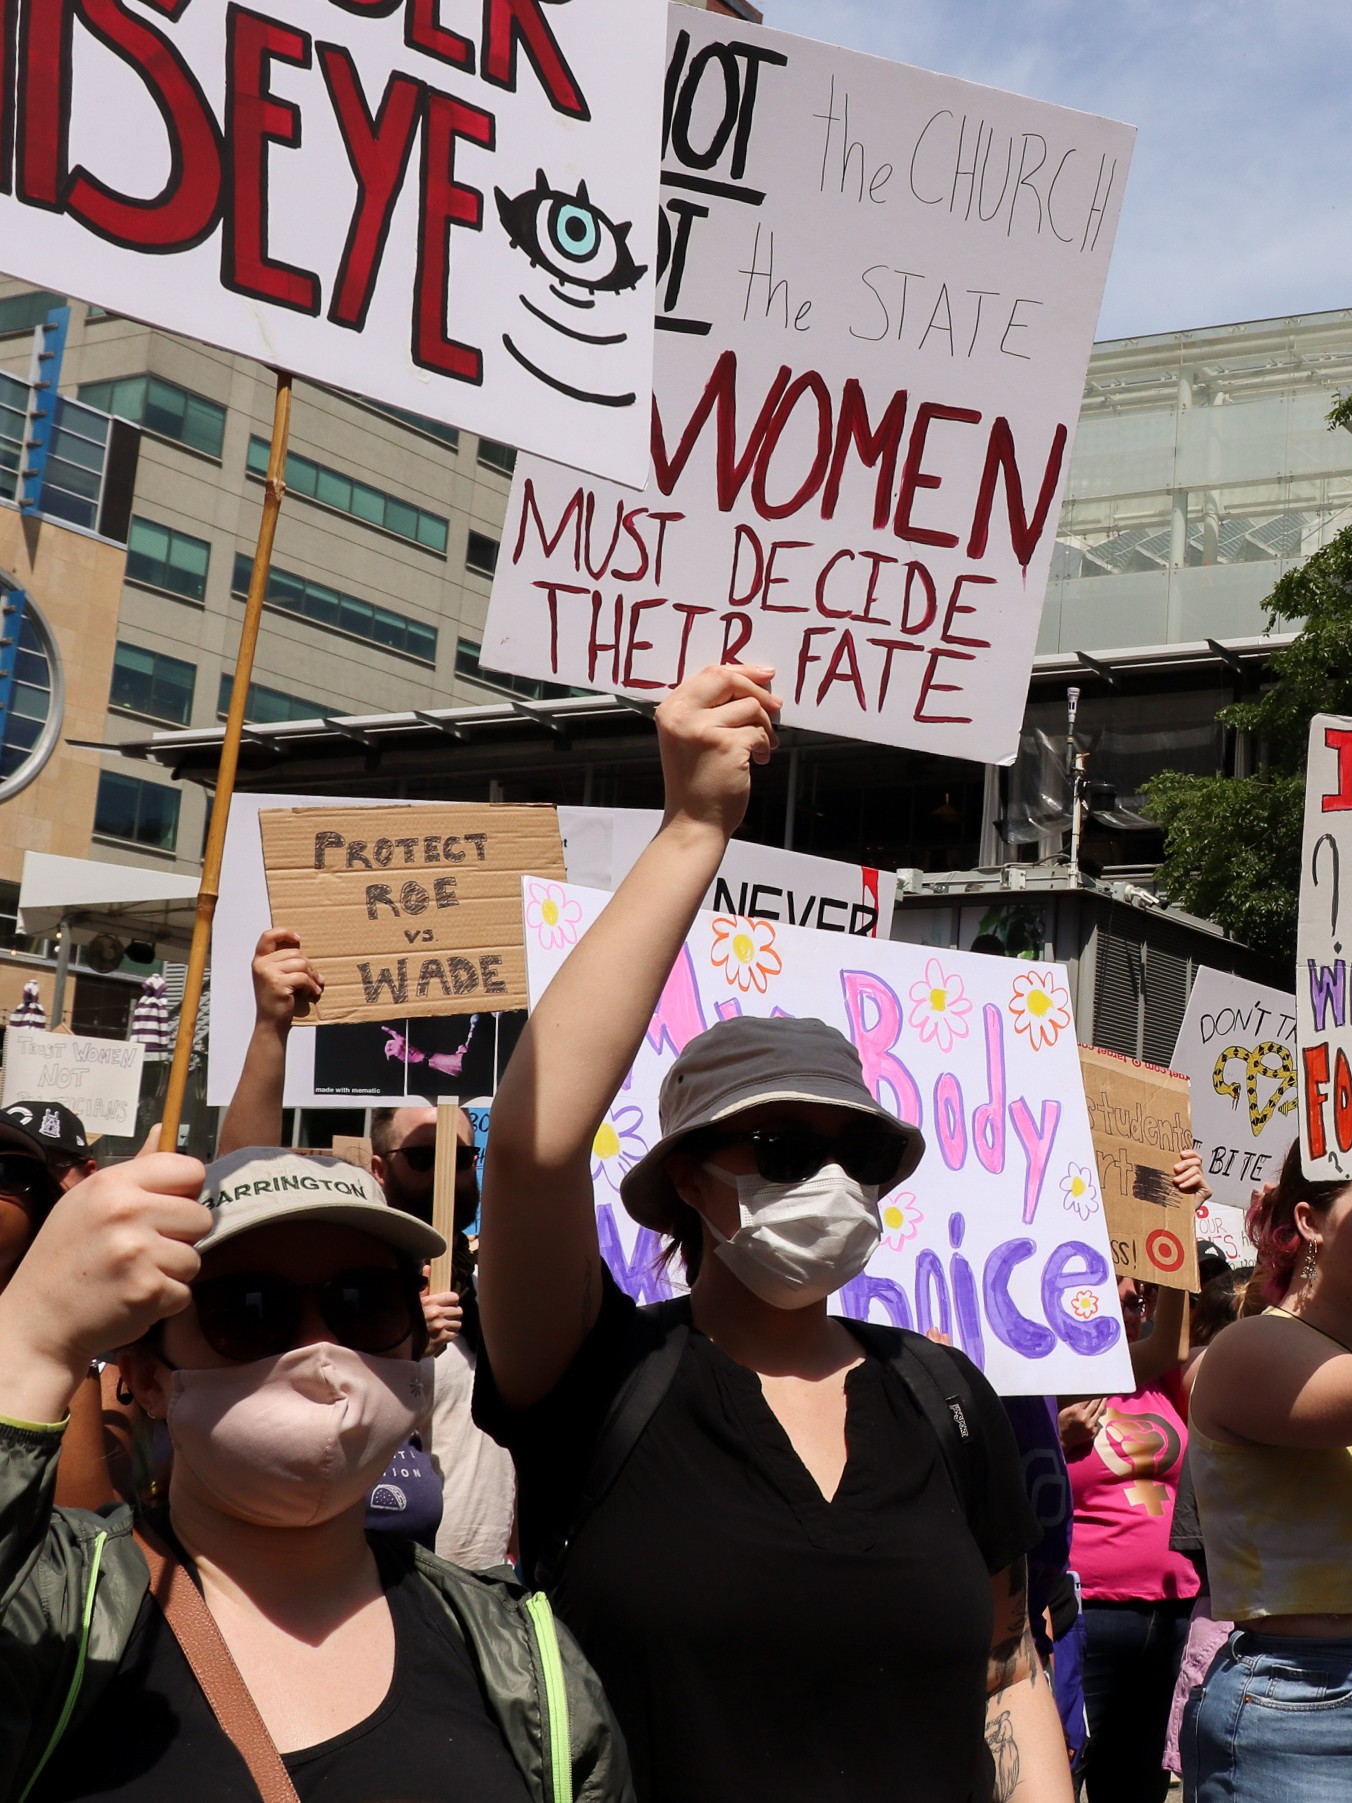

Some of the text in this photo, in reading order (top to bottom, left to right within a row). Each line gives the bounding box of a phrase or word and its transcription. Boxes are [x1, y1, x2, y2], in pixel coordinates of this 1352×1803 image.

[812, 73, 894, 203] the
[910, 110, 1117, 252] CHURCH
[738, 222, 812, 331] the
[849, 264, 1044, 360] STATE
[652, 350, 1068, 575] WOMEN
[513, 479, 998, 649] MUST DECIDE
[531, 581, 977, 724] THEIR FATE
[365, 877, 460, 921] ROE
[712, 877, 880, 937] NEVER
[357, 955, 508, 1004] WADE
[1200, 1001, 1272, 1045] DON'T
[37, 1063, 91, 1089] NOT
[72, 1042, 138, 1069] WOMEN
[840, 968, 1062, 1224] Body
[839, 1211, 1121, 1374] hoice
